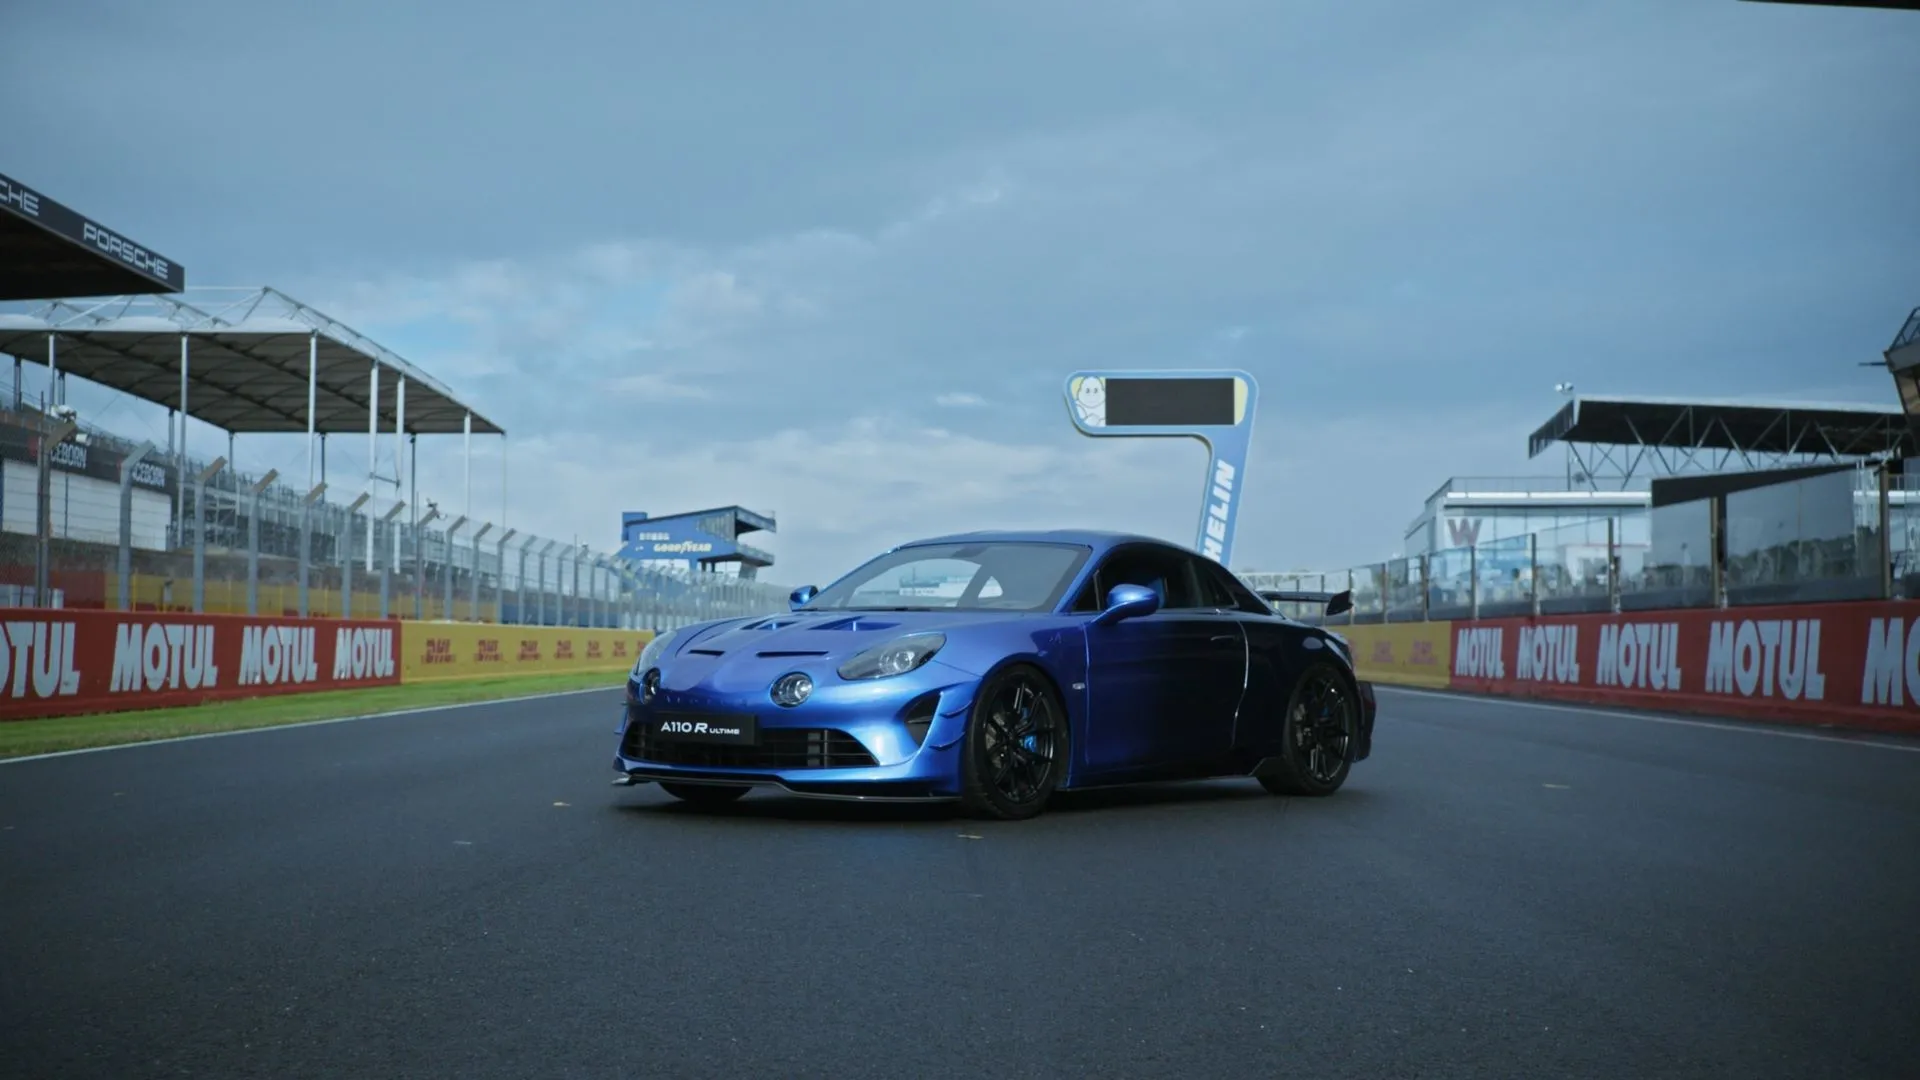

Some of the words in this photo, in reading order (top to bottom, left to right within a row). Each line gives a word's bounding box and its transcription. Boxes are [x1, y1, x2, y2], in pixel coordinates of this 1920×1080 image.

[83, 222, 169, 280] PORSCHE
[653, 540, 712, 554] GOODYEAR
[109, 622, 218, 692] MOTUL
[238, 625, 318, 685] MOTUL
[333, 627, 394, 680] MOTUL
[1455, 627, 1505, 680] MOTUL
[1516, 624, 1580, 684] MOTUL
[1596, 622, 1682, 690] MOTUL
[1705, 618, 1826, 701] MOTUL
[660, 721, 692, 734] A110
[694, 722, 709, 734] R
